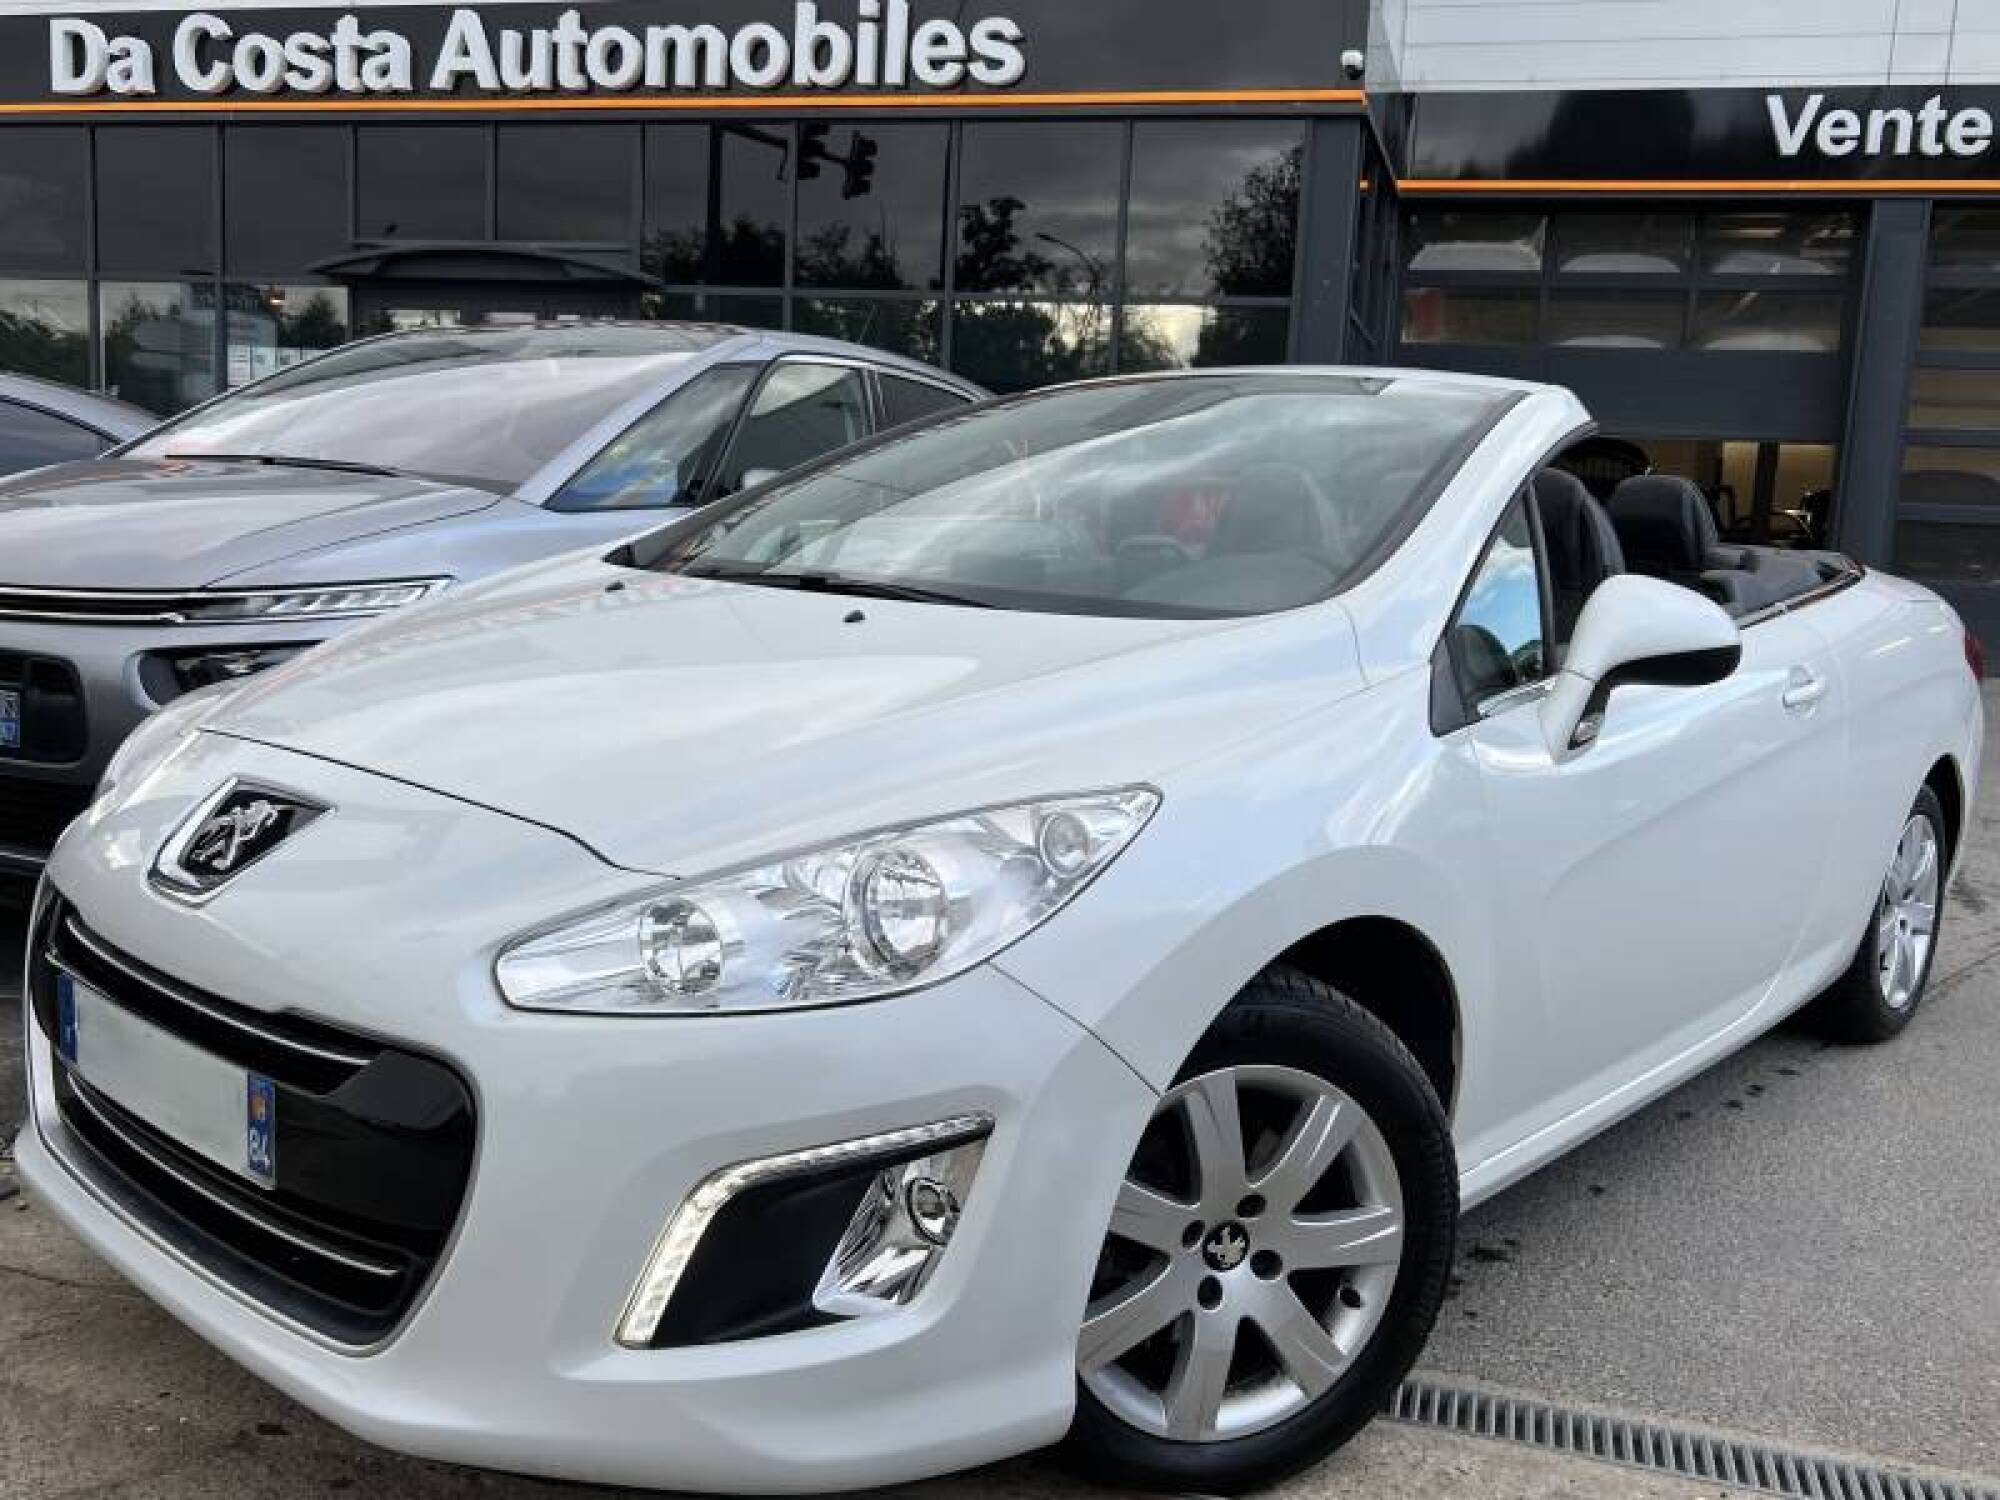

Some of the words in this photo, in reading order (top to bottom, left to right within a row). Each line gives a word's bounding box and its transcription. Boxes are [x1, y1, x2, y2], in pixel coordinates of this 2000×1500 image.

[50, 18, 155, 94] Da
[173, 12, 412, 93] Costa
[429, 0, 1026, 91] Automobiles
[1766, 94, 1994, 156] Vente
